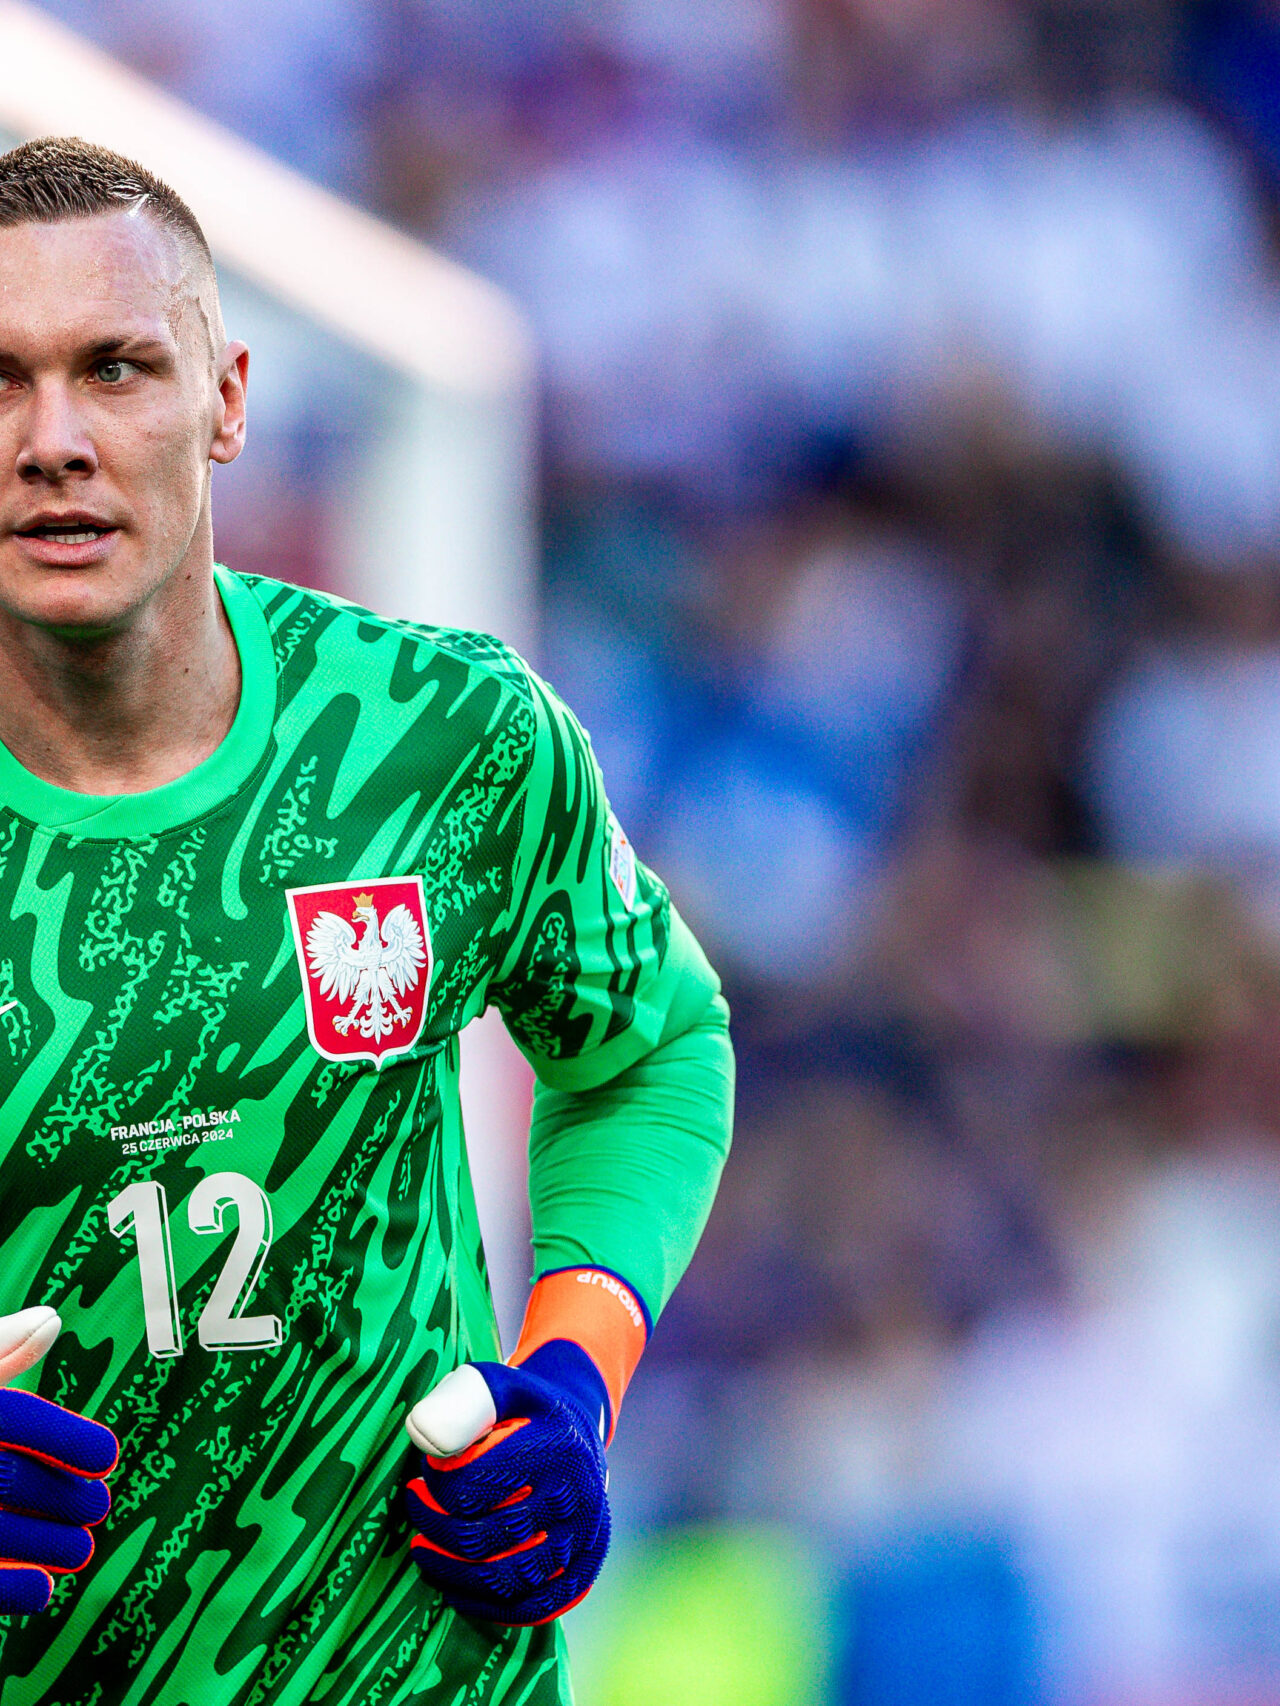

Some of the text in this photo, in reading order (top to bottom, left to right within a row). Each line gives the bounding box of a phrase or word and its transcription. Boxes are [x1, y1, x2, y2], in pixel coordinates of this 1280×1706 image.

[110, 1118, 176, 1141] FRANCJA
[183, 1109, 241, 1129] POLSKA
[121, 1128, 234, 1155] 25 CZERWCA 2024
[107, 1171, 282, 1359] 12
[576, 1271, 643, 1327] SKORUP
